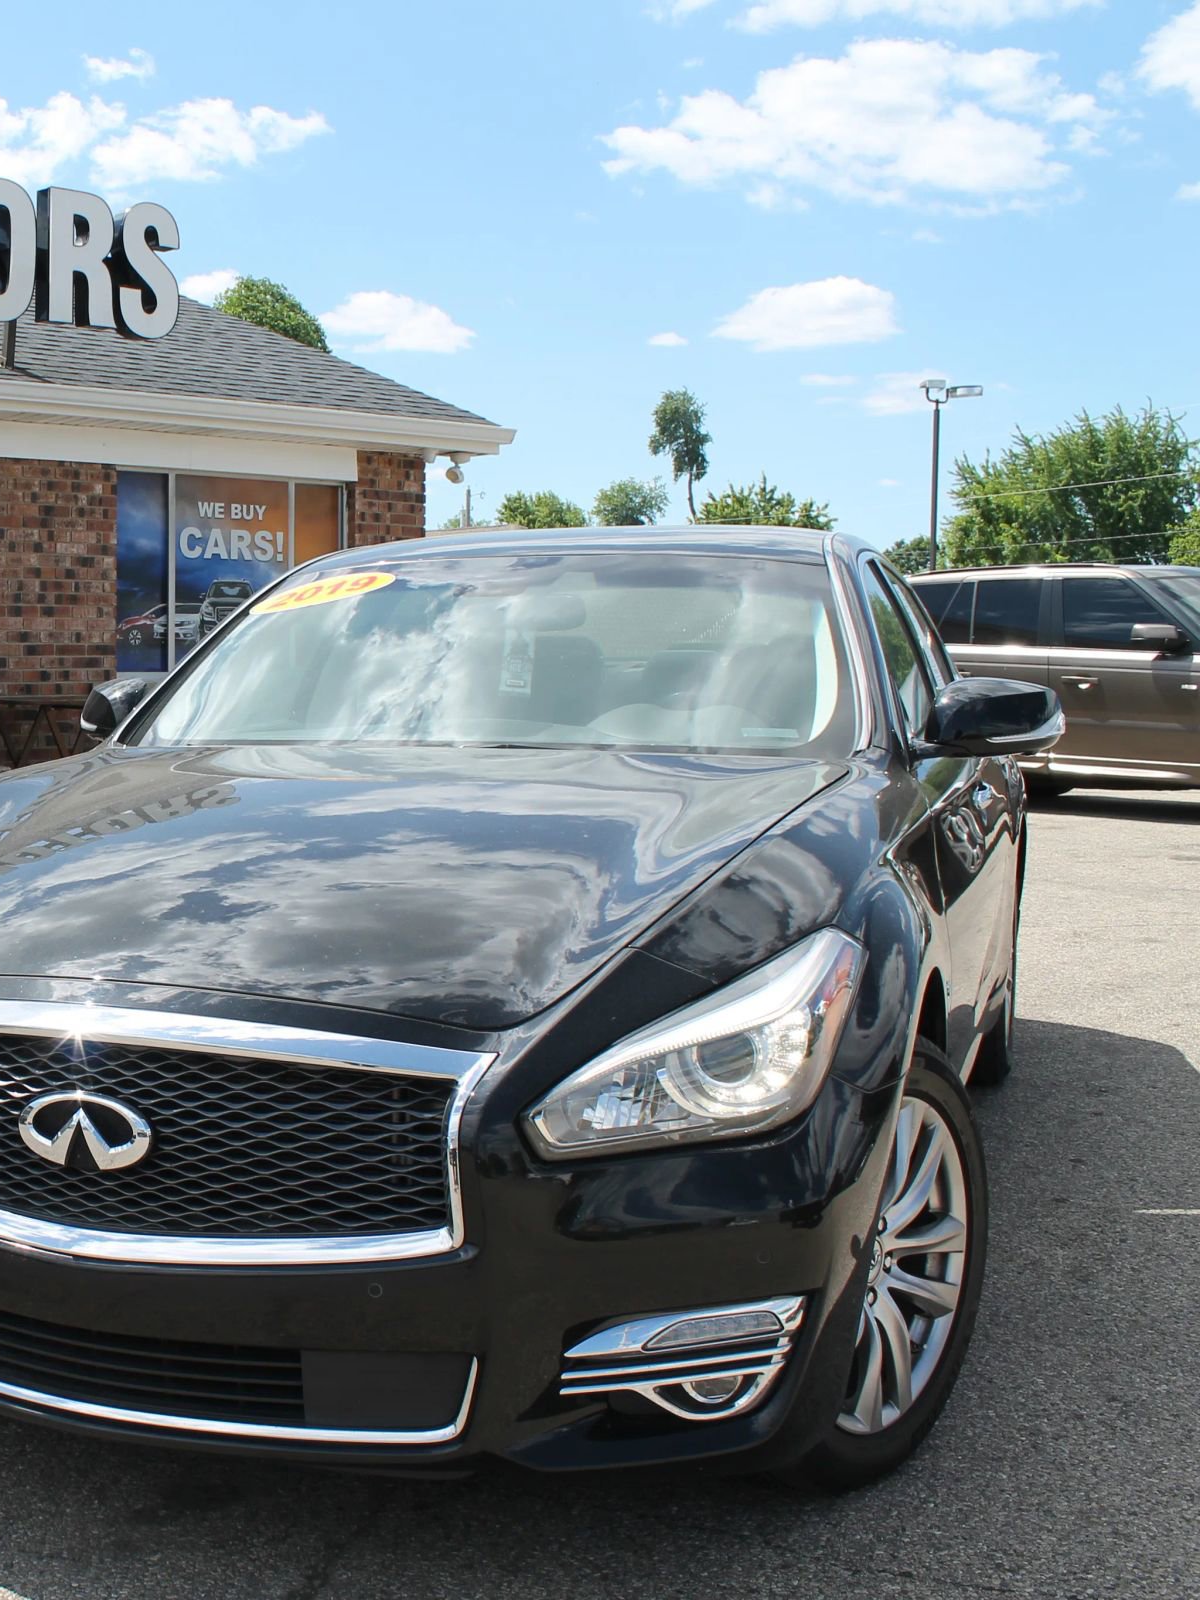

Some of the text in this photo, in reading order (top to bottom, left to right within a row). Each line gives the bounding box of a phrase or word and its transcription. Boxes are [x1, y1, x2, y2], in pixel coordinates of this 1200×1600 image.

[197, 502, 267, 520] WE BUY
[180, 527, 284, 562] CARS!
[265, 575, 379, 610] 2019
